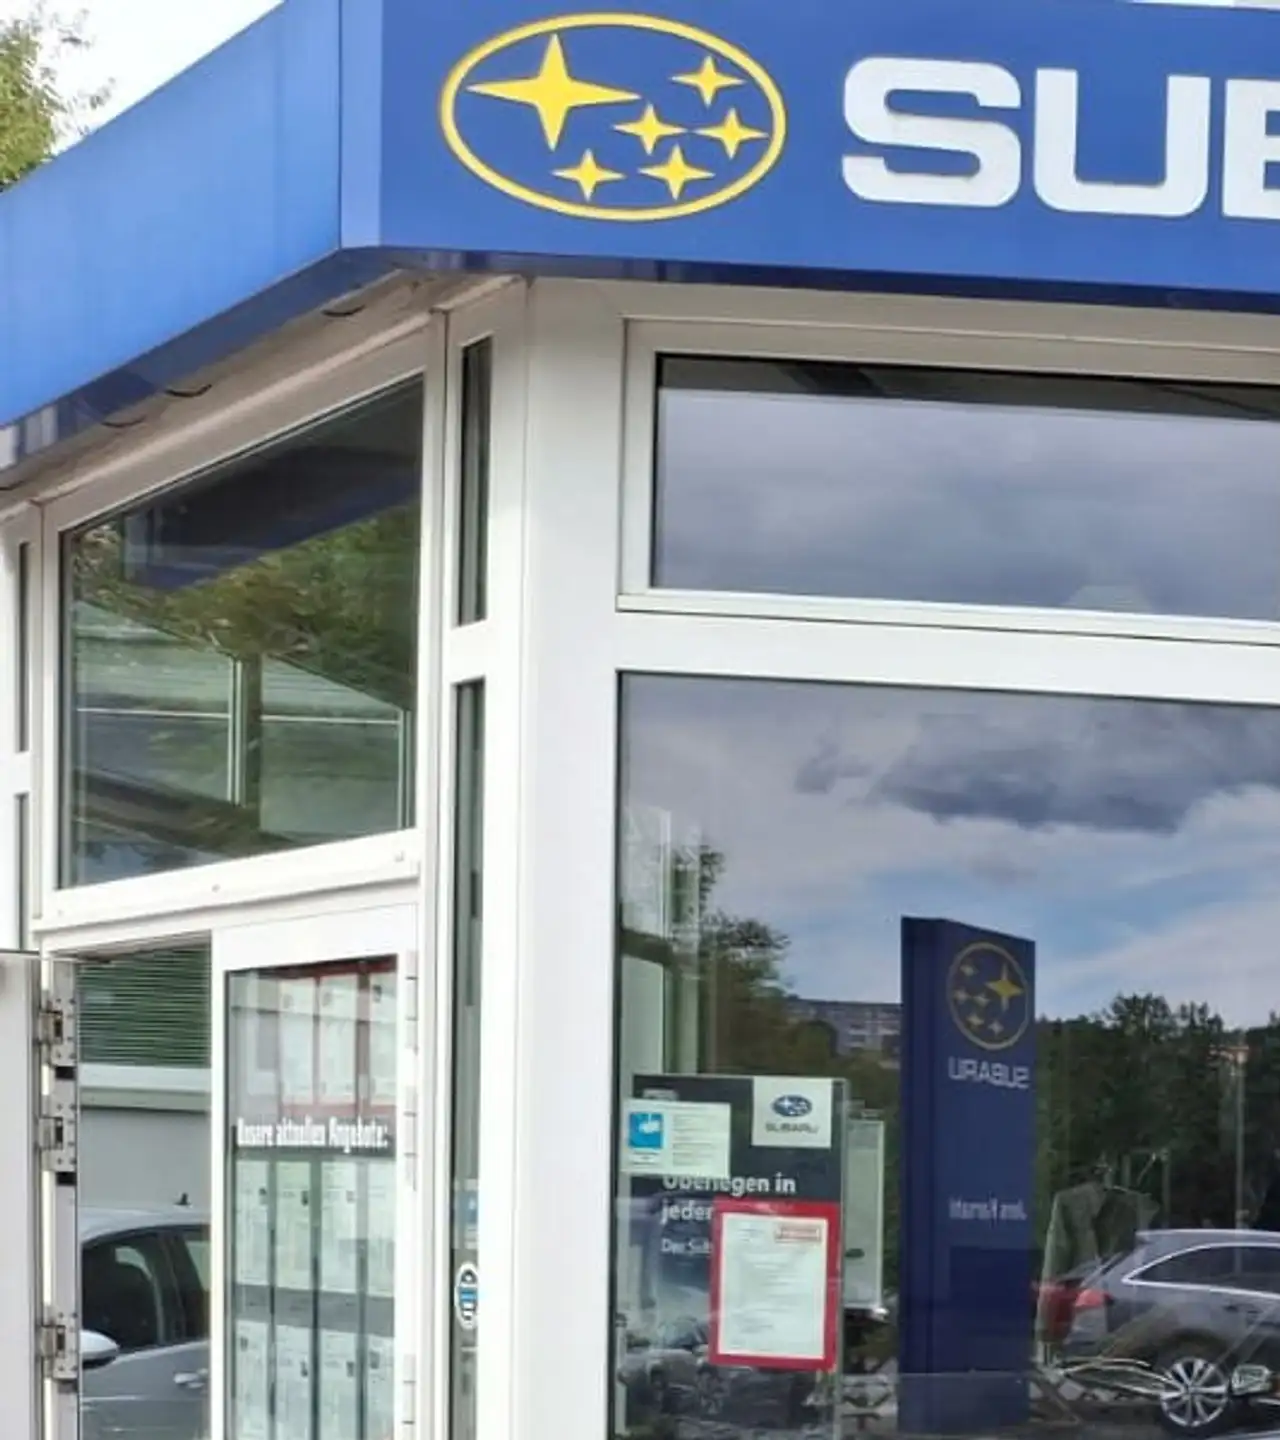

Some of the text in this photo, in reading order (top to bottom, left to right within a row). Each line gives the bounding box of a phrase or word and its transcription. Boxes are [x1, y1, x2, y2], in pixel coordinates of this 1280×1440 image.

[765, 1121, 820, 1135] SUBARU
[775, 1172, 797, 1194] in
[660, 1199, 713, 1225] jeder
